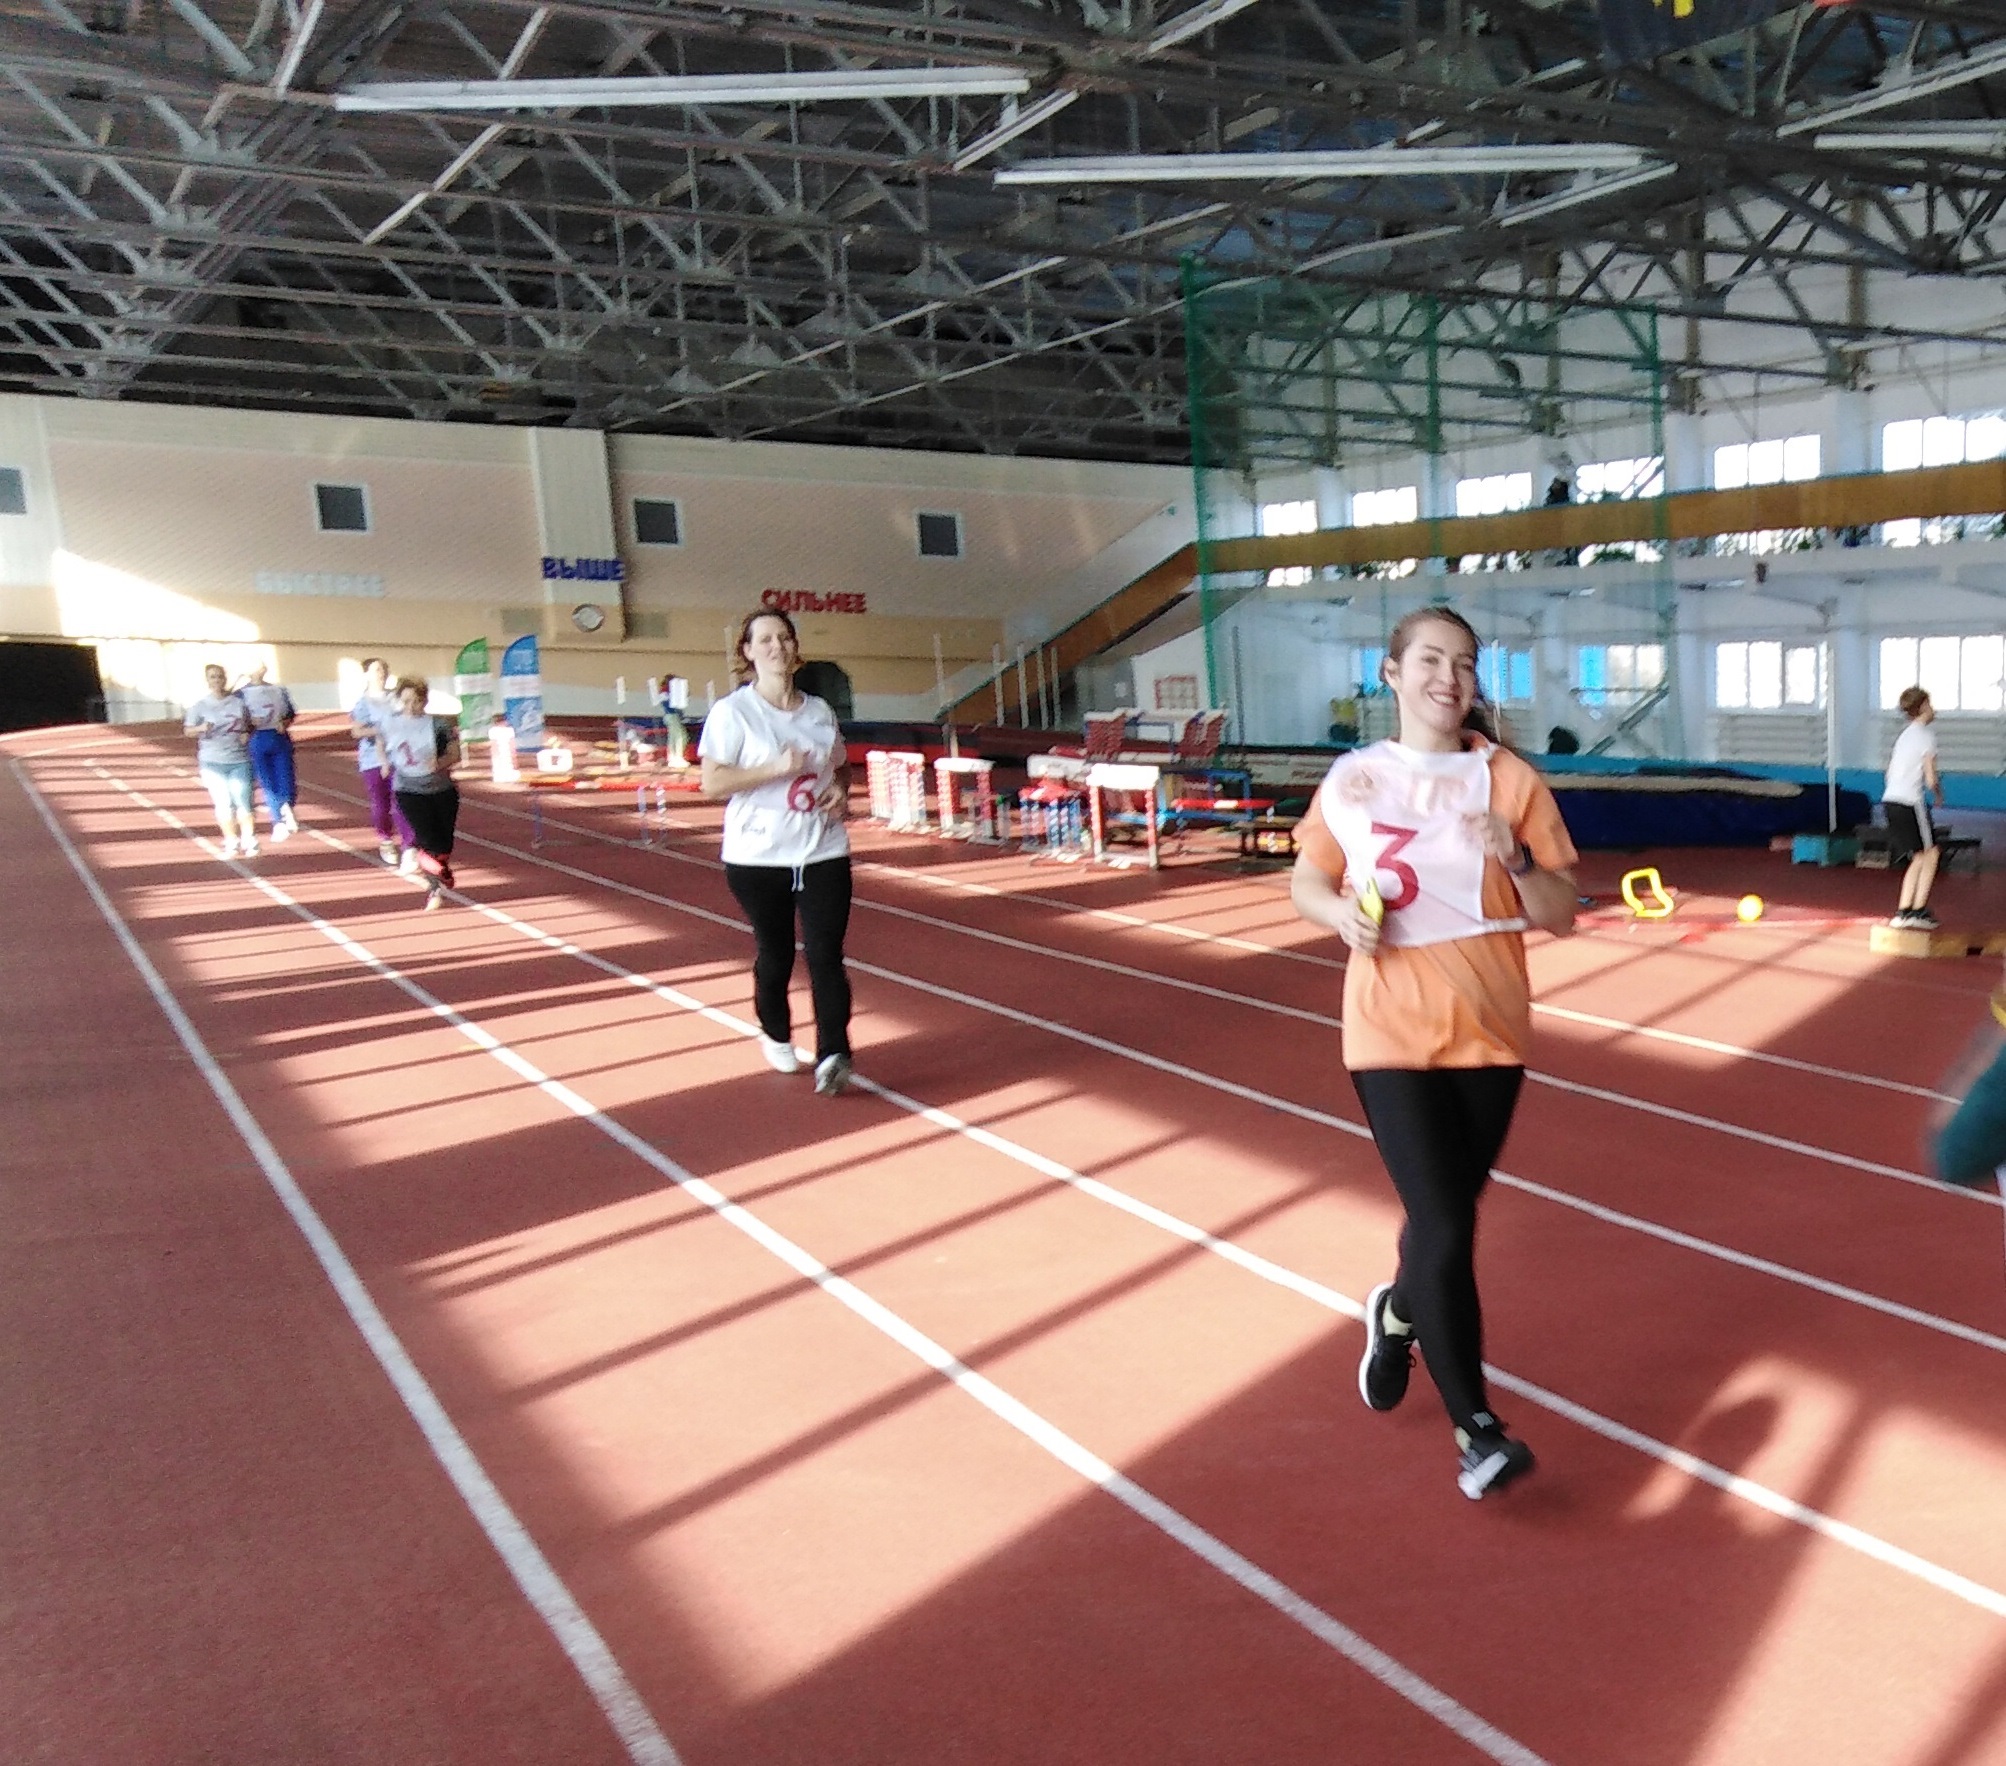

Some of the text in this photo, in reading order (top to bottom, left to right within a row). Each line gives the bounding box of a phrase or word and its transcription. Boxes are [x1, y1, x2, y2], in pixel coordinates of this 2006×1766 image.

[542, 558, 624, 580] ВЫШЕ
[762, 590, 867, 613] СИЛЬНЕЕ
[788, 773, 817, 812] 6
[1371, 822, 1419, 911] 3
